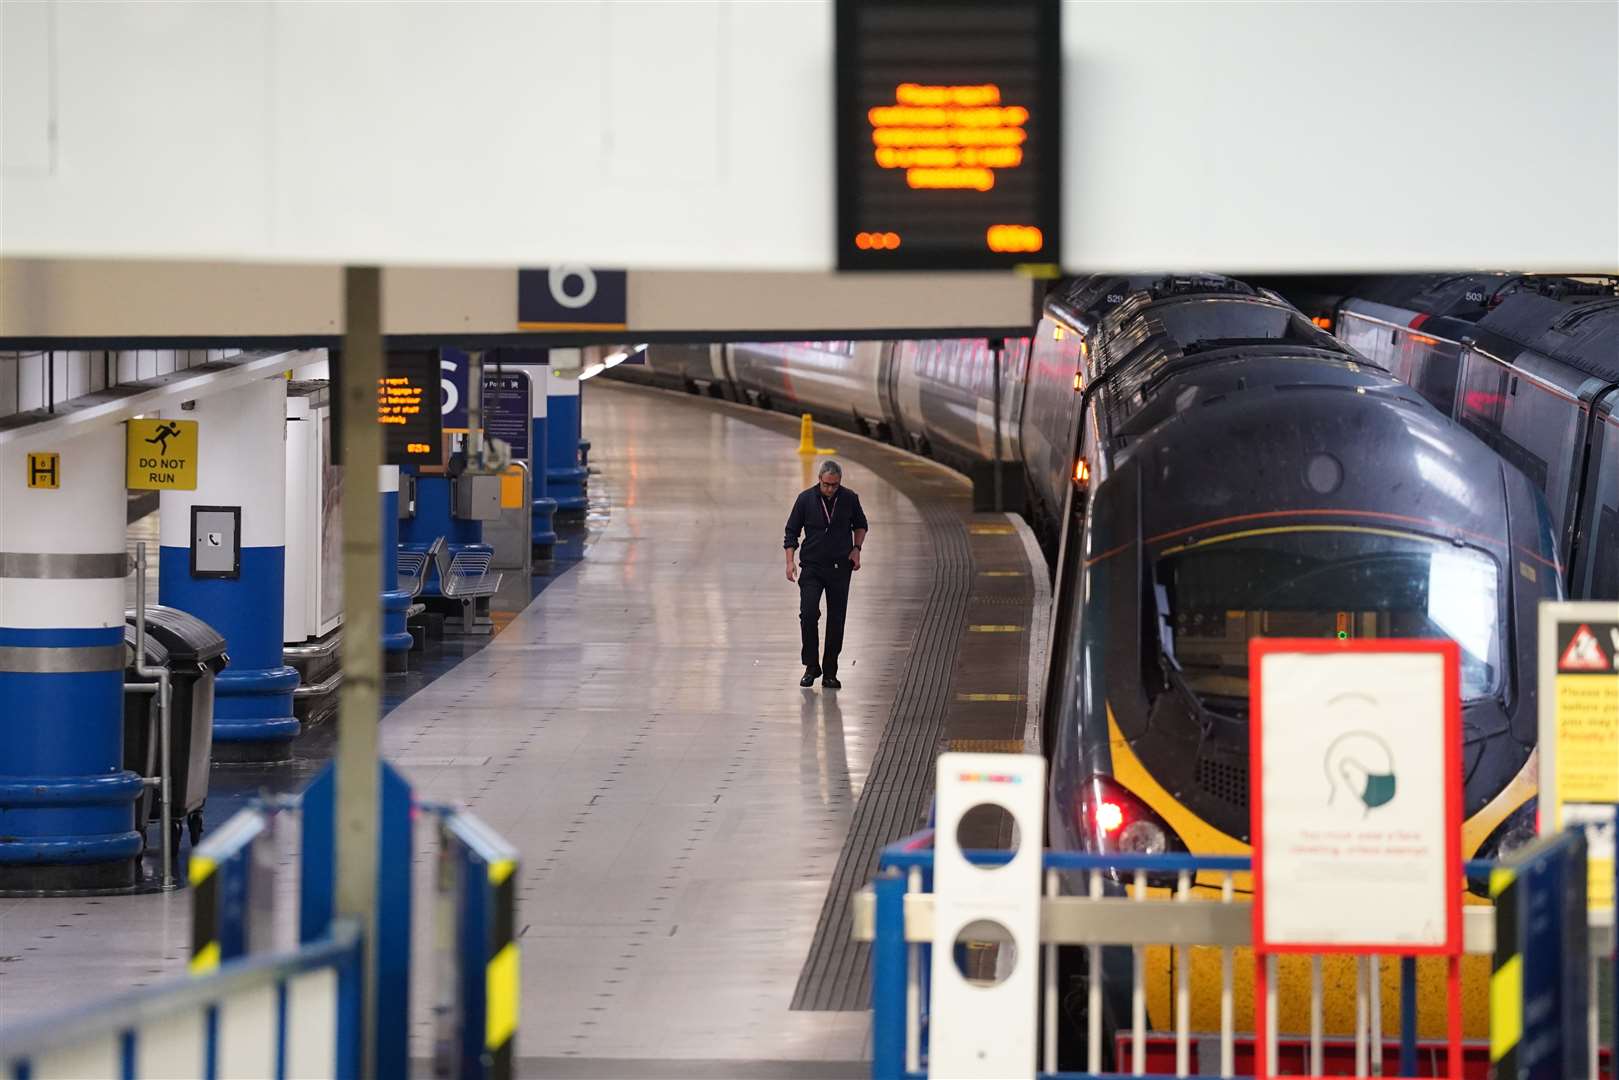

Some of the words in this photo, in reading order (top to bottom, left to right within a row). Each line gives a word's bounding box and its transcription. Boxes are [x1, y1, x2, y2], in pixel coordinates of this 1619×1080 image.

[548, 264, 597, 309] 6
[32, 456, 56, 486] H
[139, 458, 158, 469] DO
[160, 458, 186, 469] NOT
[149, 473, 175, 483] RUN
